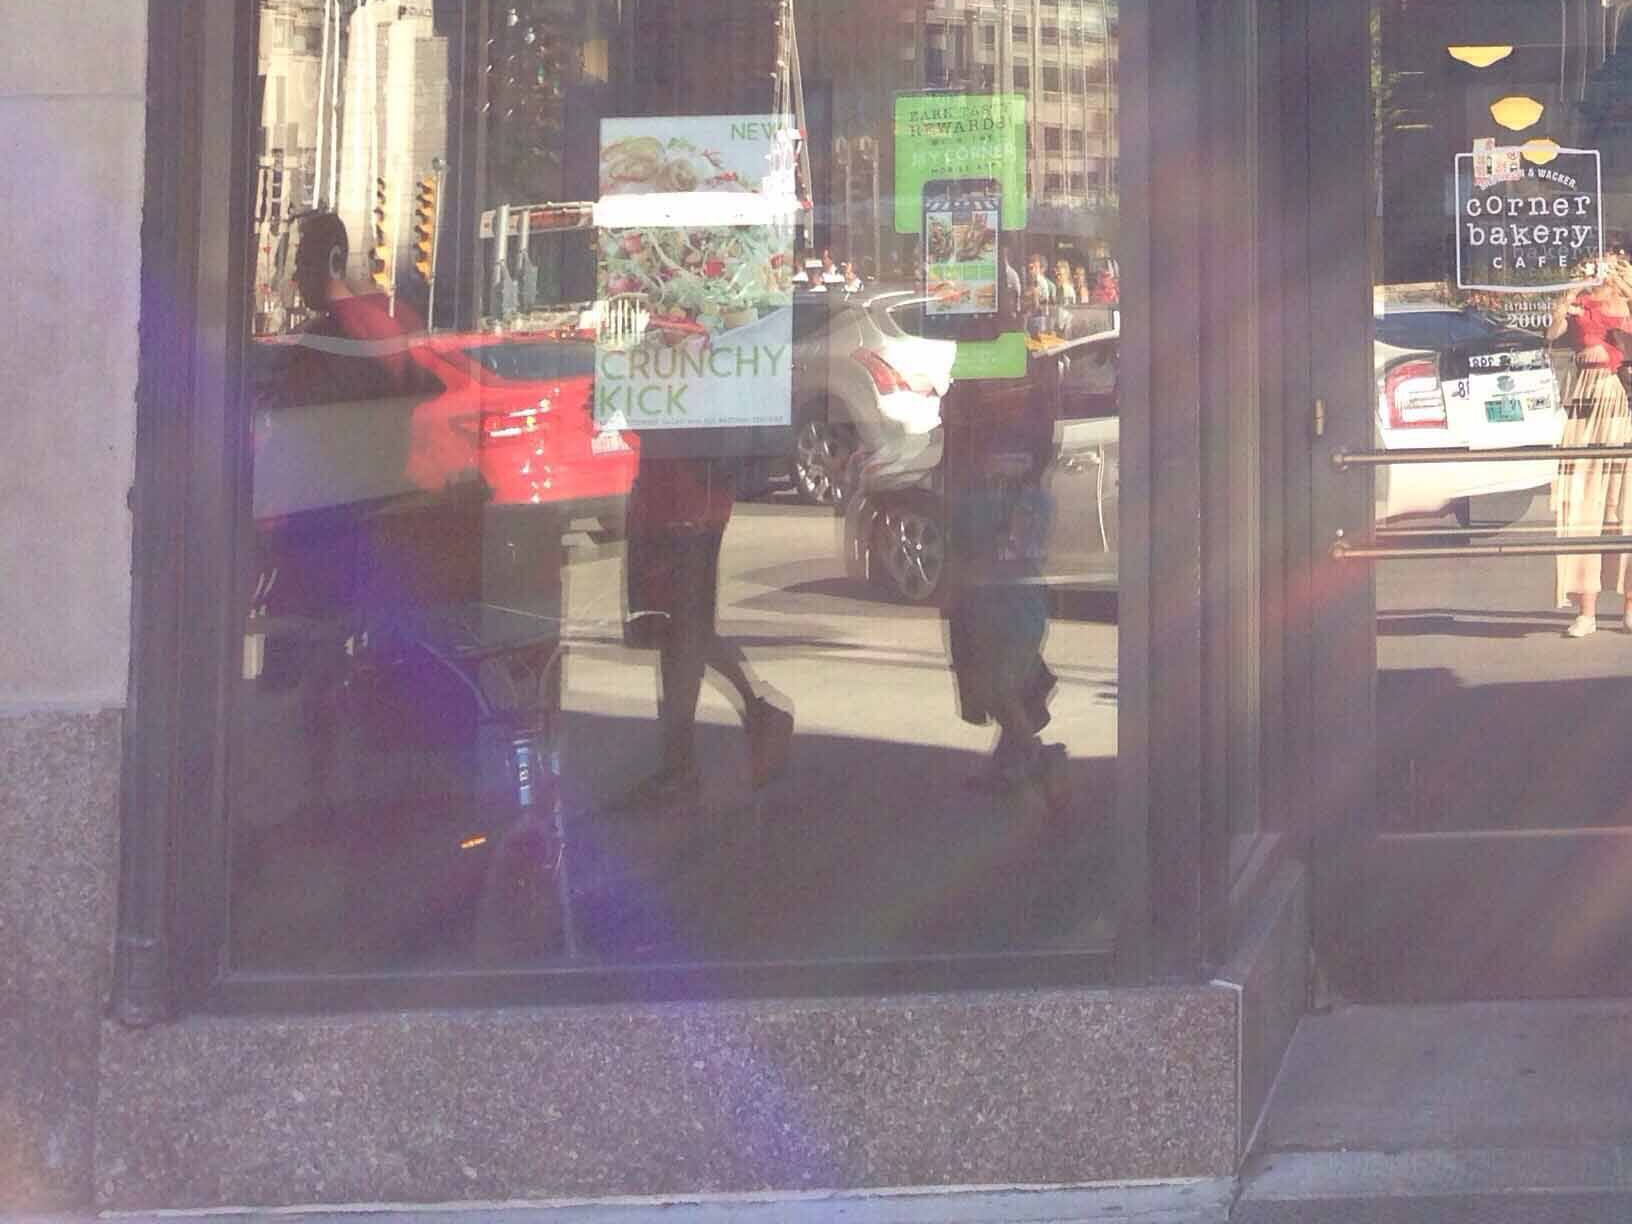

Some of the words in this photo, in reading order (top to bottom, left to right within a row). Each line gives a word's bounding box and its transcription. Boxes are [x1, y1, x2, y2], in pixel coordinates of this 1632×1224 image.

[1537, 167, 1577, 189] WACKER
[1466, 194, 1591, 217] corner
[1466, 223, 1592, 248] bakery
[1493, 255, 1568, 269] CAFE
[1507, 313, 1553, 328] 2000
[601, 345, 786, 381] CRUNCHY
[601, 384, 689, 416] KICK
